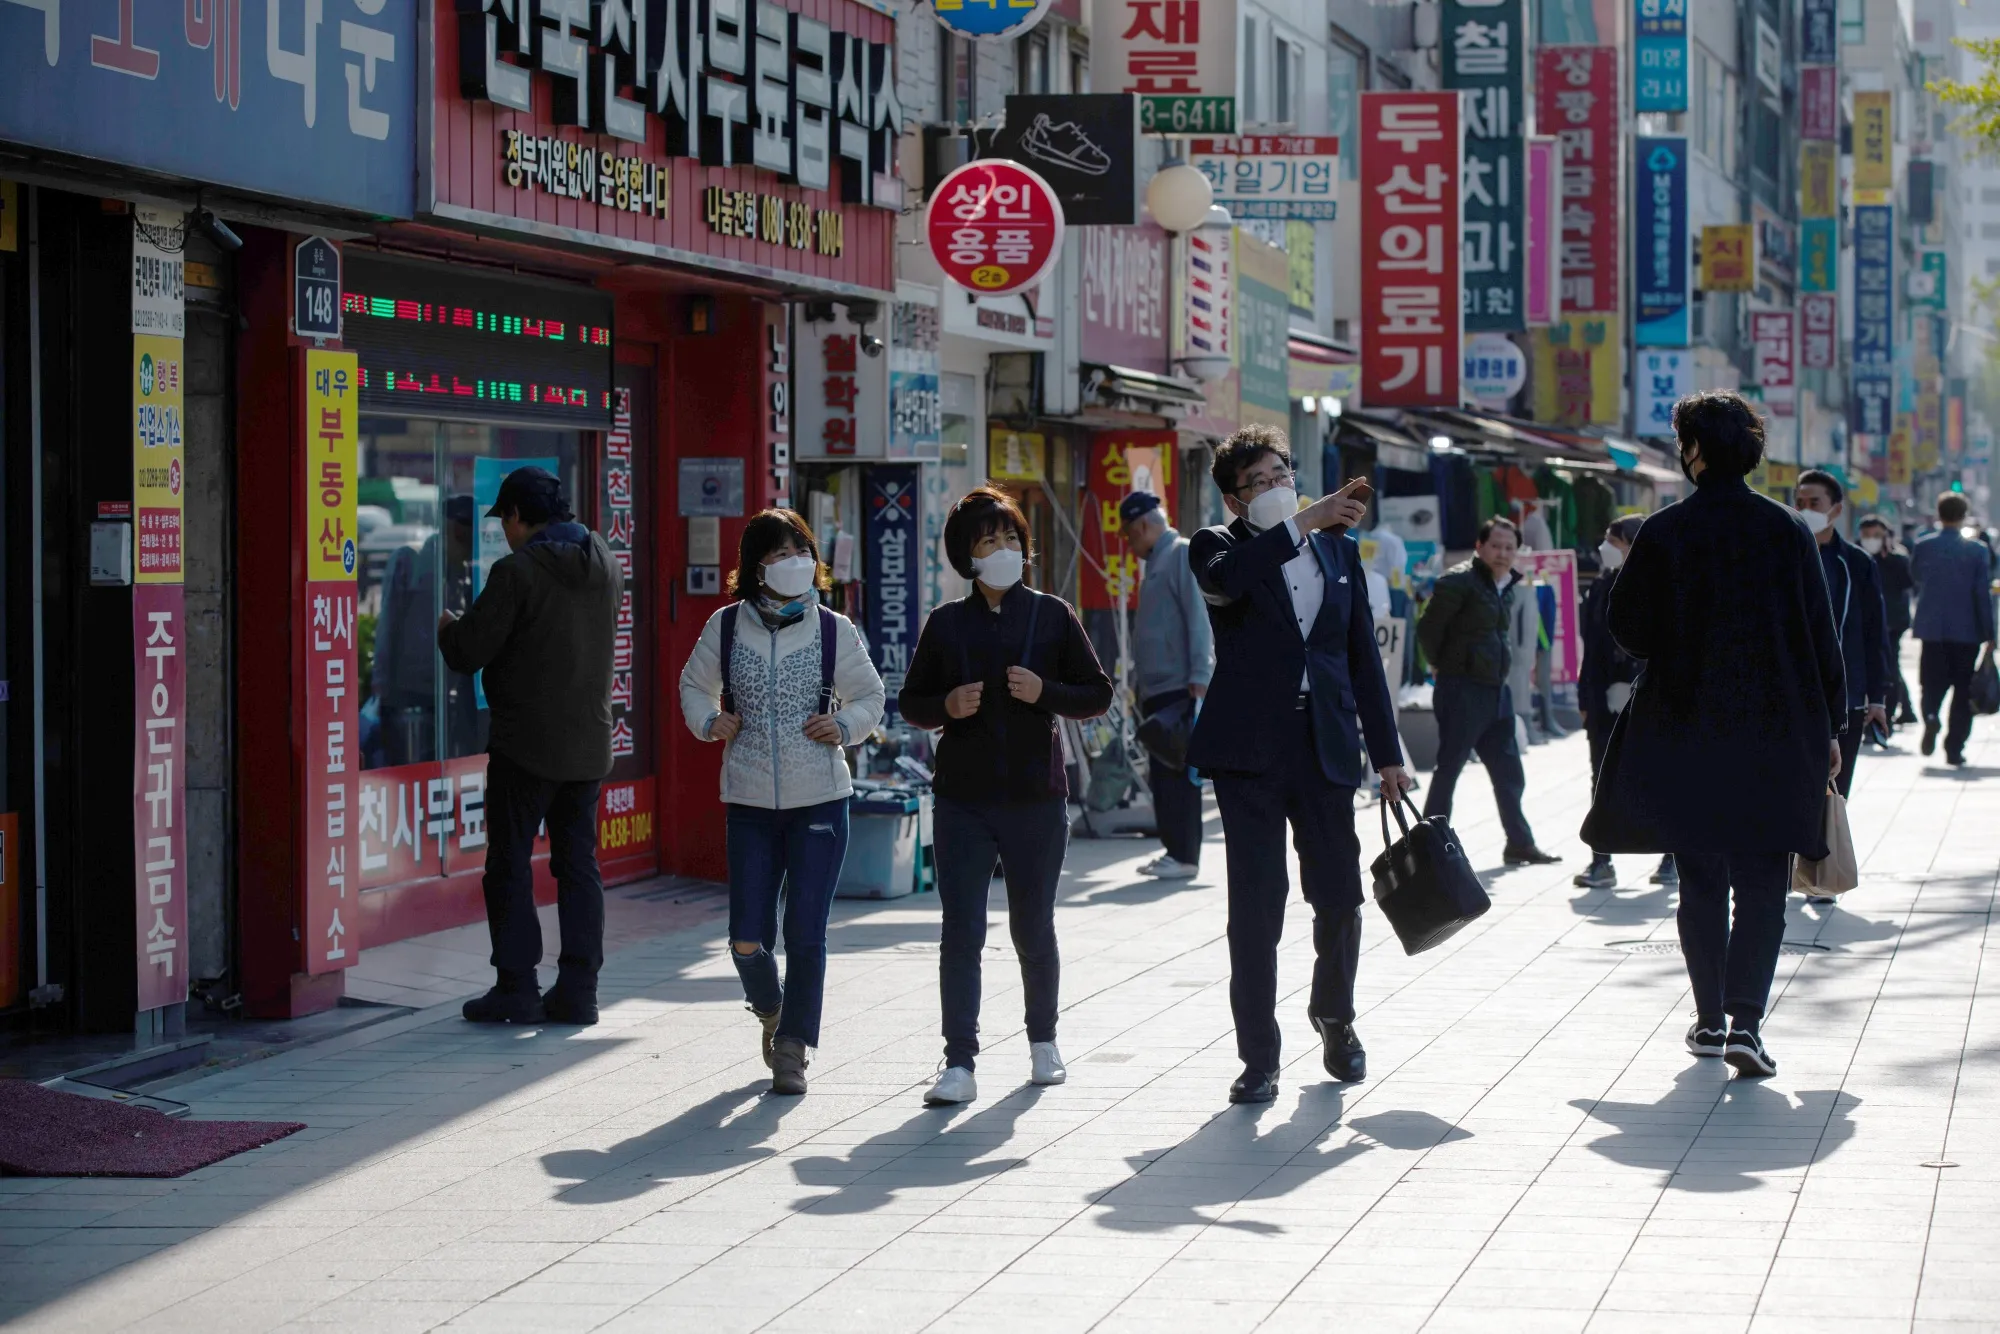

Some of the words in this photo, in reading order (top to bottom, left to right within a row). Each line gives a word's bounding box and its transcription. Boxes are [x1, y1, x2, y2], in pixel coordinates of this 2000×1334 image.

[507, 129, 596, 201] 정부지원없이
[600, 153, 669, 220] 운영합니다
[1198, 159, 1330, 194] 한일기업
[706, 185, 758, 239] 나눔전화
[947, 183, 1031, 221] 성인
[947, 228, 1034, 265] 용품
[1376, 103, 1448, 395] 두산의료기
[306, 285, 332, 324] 148
[316, 368, 349, 398] 대우
[138, 404, 181, 447] 직업소개소
[318, 407, 344, 563] 부동산
[344, 547, 355, 566] 2F
[313, 594, 353, 651] 천사
[145, 611, 177, 977] 주은귀금속
[326, 659, 346, 961] 무료급식소
